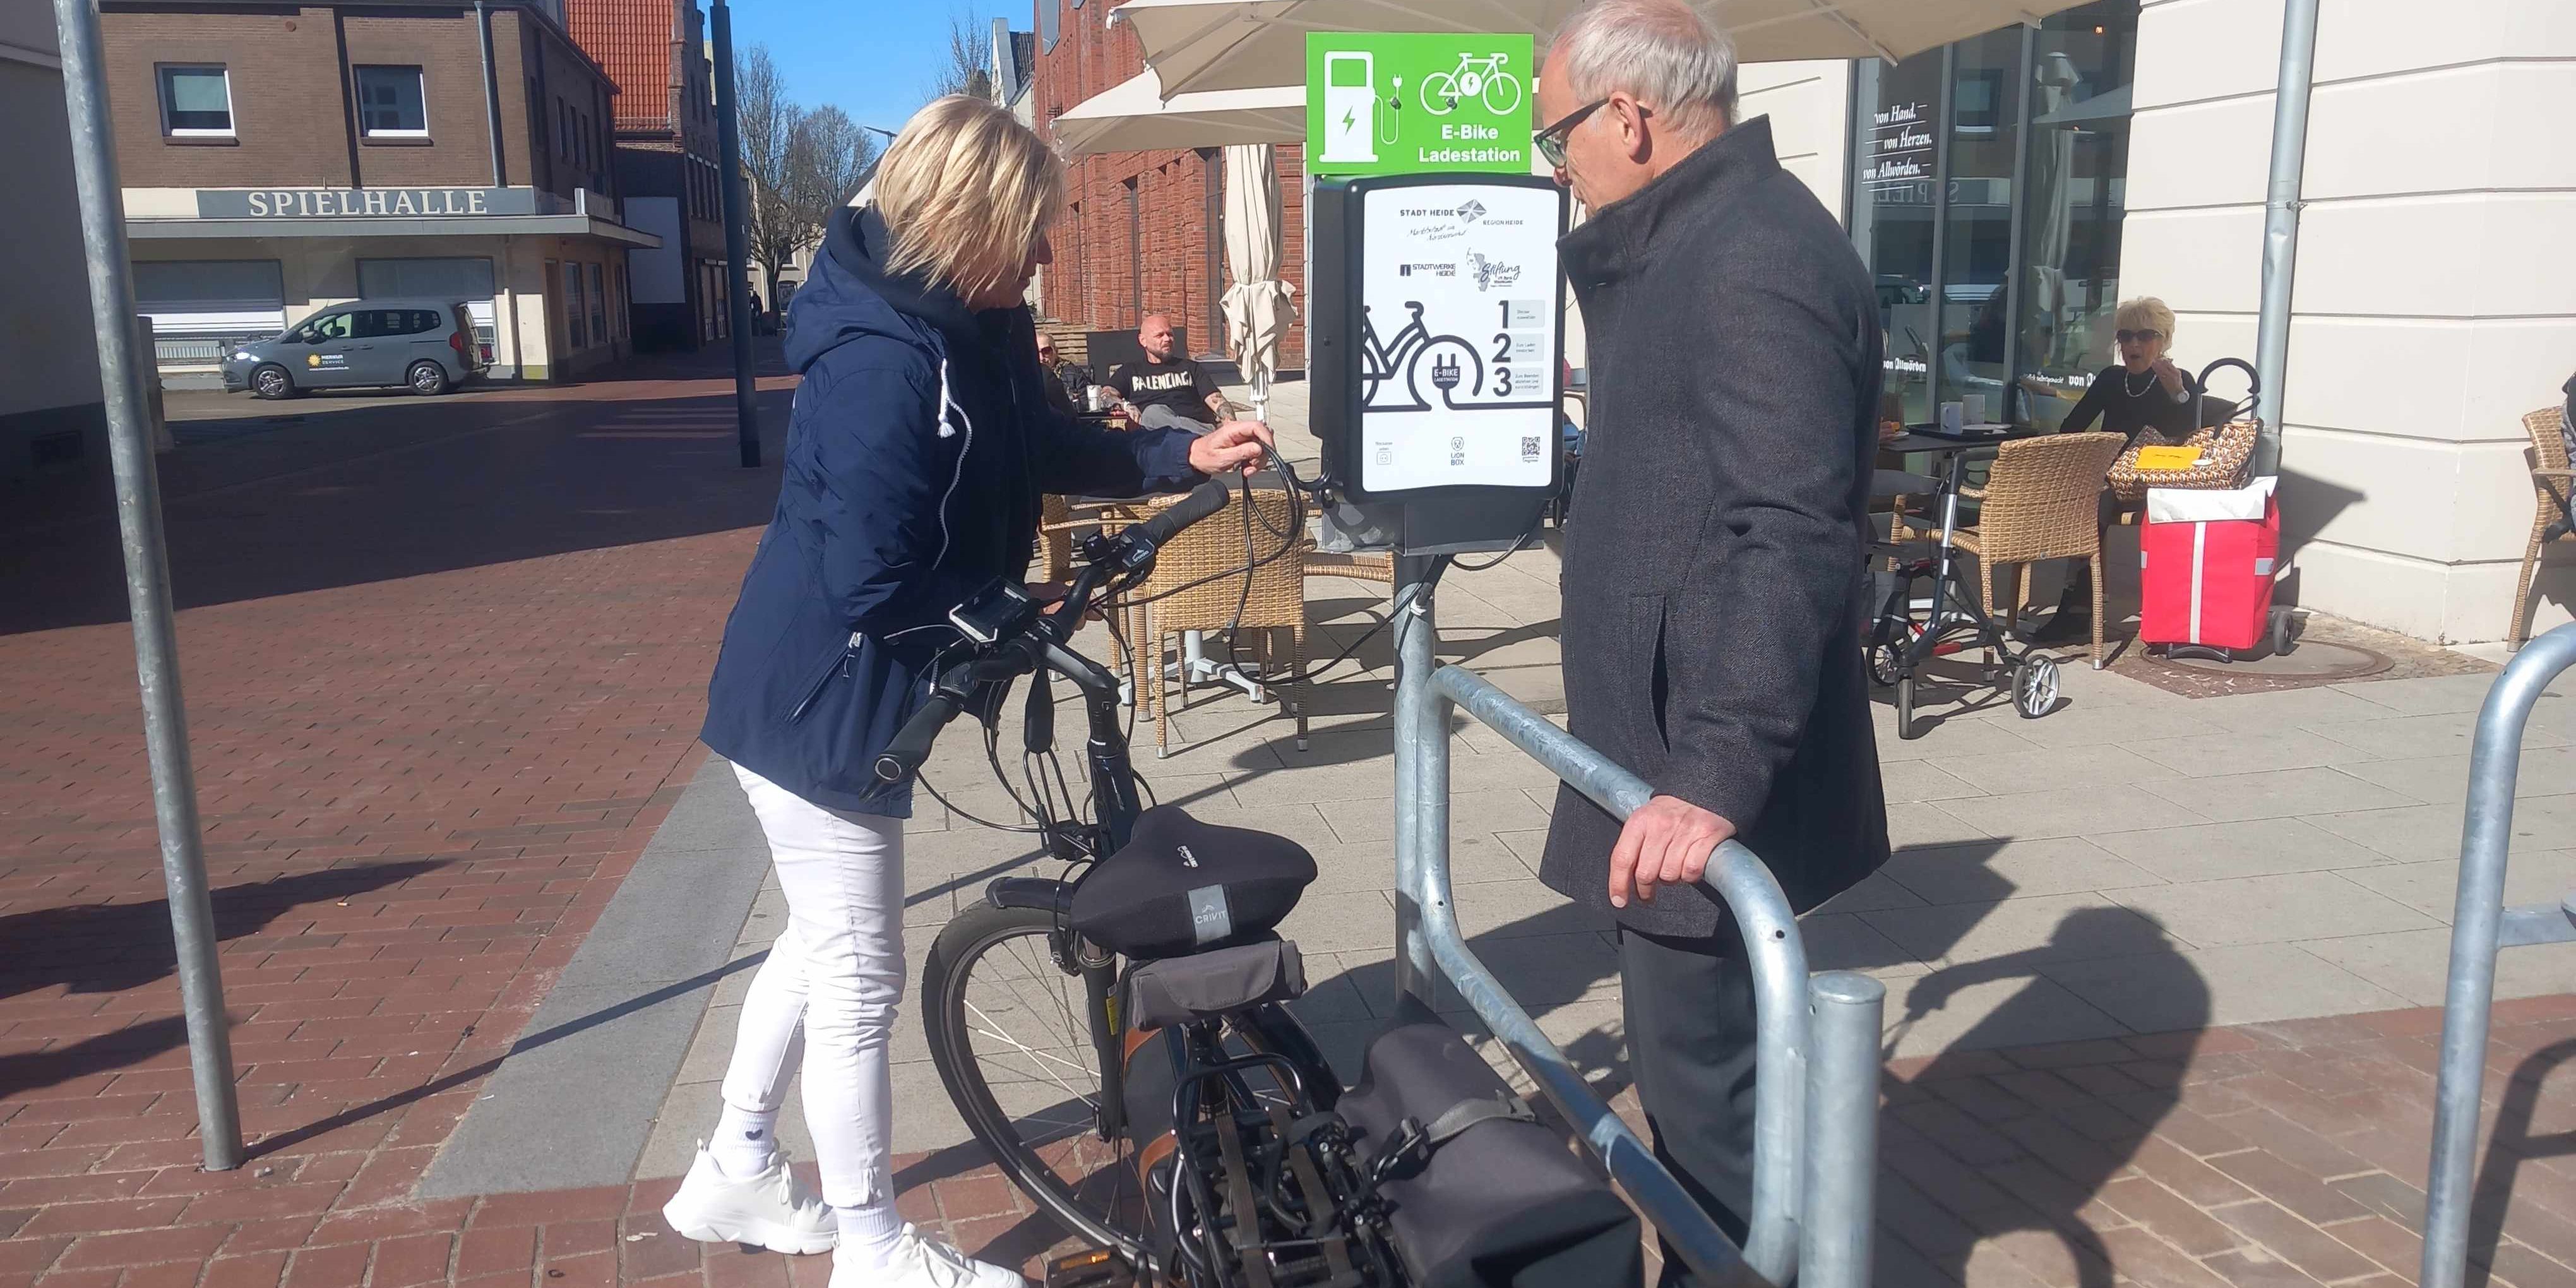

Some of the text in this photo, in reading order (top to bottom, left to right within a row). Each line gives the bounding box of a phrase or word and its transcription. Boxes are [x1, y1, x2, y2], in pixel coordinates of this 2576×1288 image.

[1874, 102, 1916, 124] von Hand.
[1441, 124, 1498, 140] E-Bike
[1883, 126, 1932, 150] von Herzen.
[1419, 147, 1520, 163] Ladestation
[1863, 157, 1921, 180] von Allwörden.
[247, 190, 487, 217] SPIELHALLE
[1481, 261, 1520, 282] Stiftung
[1498, 300, 1509, 329] 1
[1491, 333, 1512, 363] 2
[1434, 368, 1458, 377] E-BIKE
[1493, 367, 1512, 397] 3
[2068, 375, 2084, 386] von
[1195, 910, 1226, 924] CRIVIT
